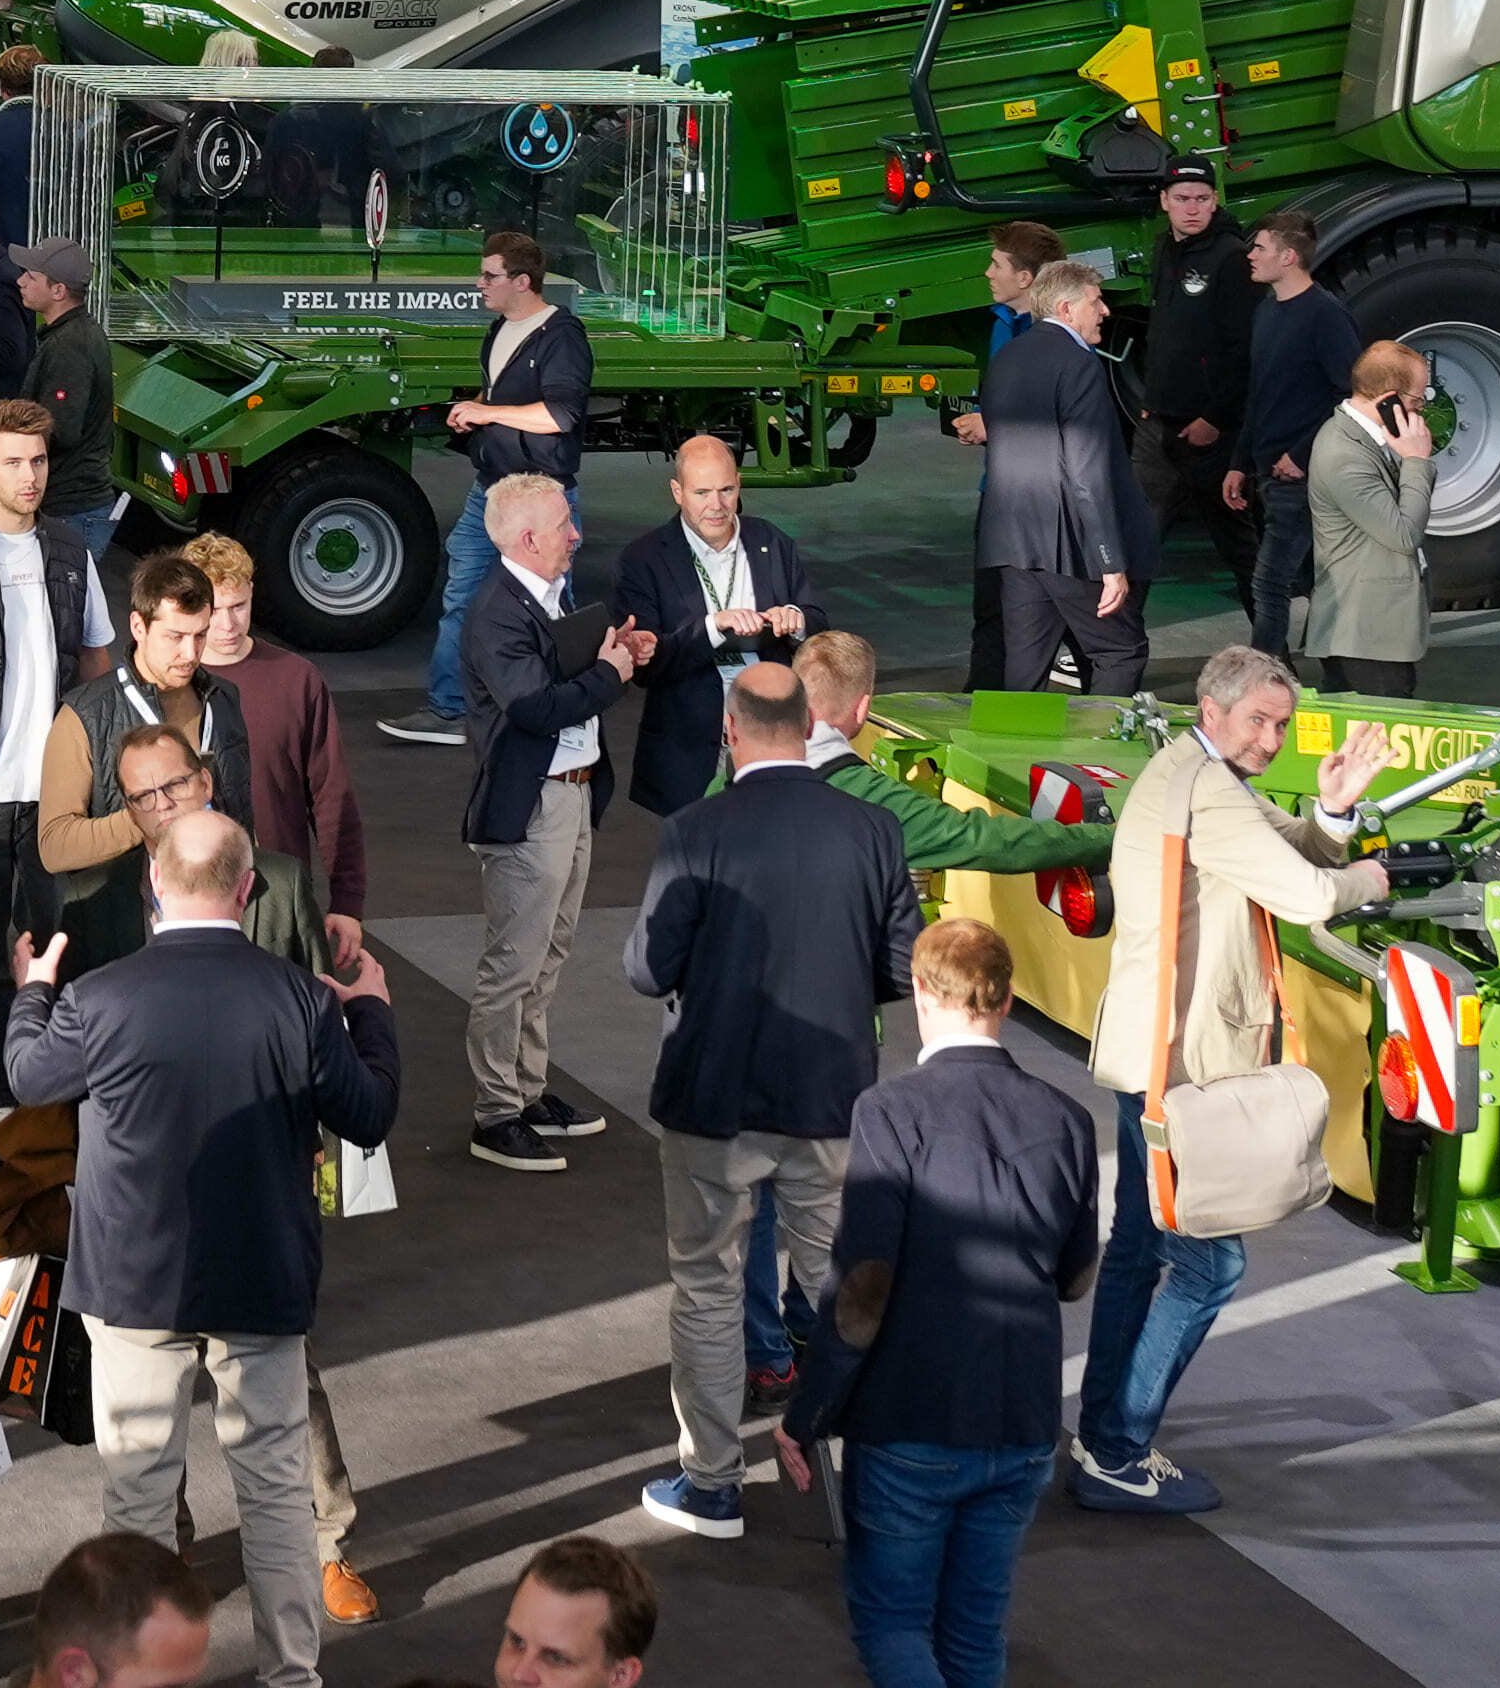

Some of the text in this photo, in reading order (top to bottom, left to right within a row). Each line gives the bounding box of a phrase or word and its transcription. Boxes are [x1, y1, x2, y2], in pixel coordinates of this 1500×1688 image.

[215, 155, 232, 168] KG
[283, 290, 483, 310] FEEL THE IMPACT
